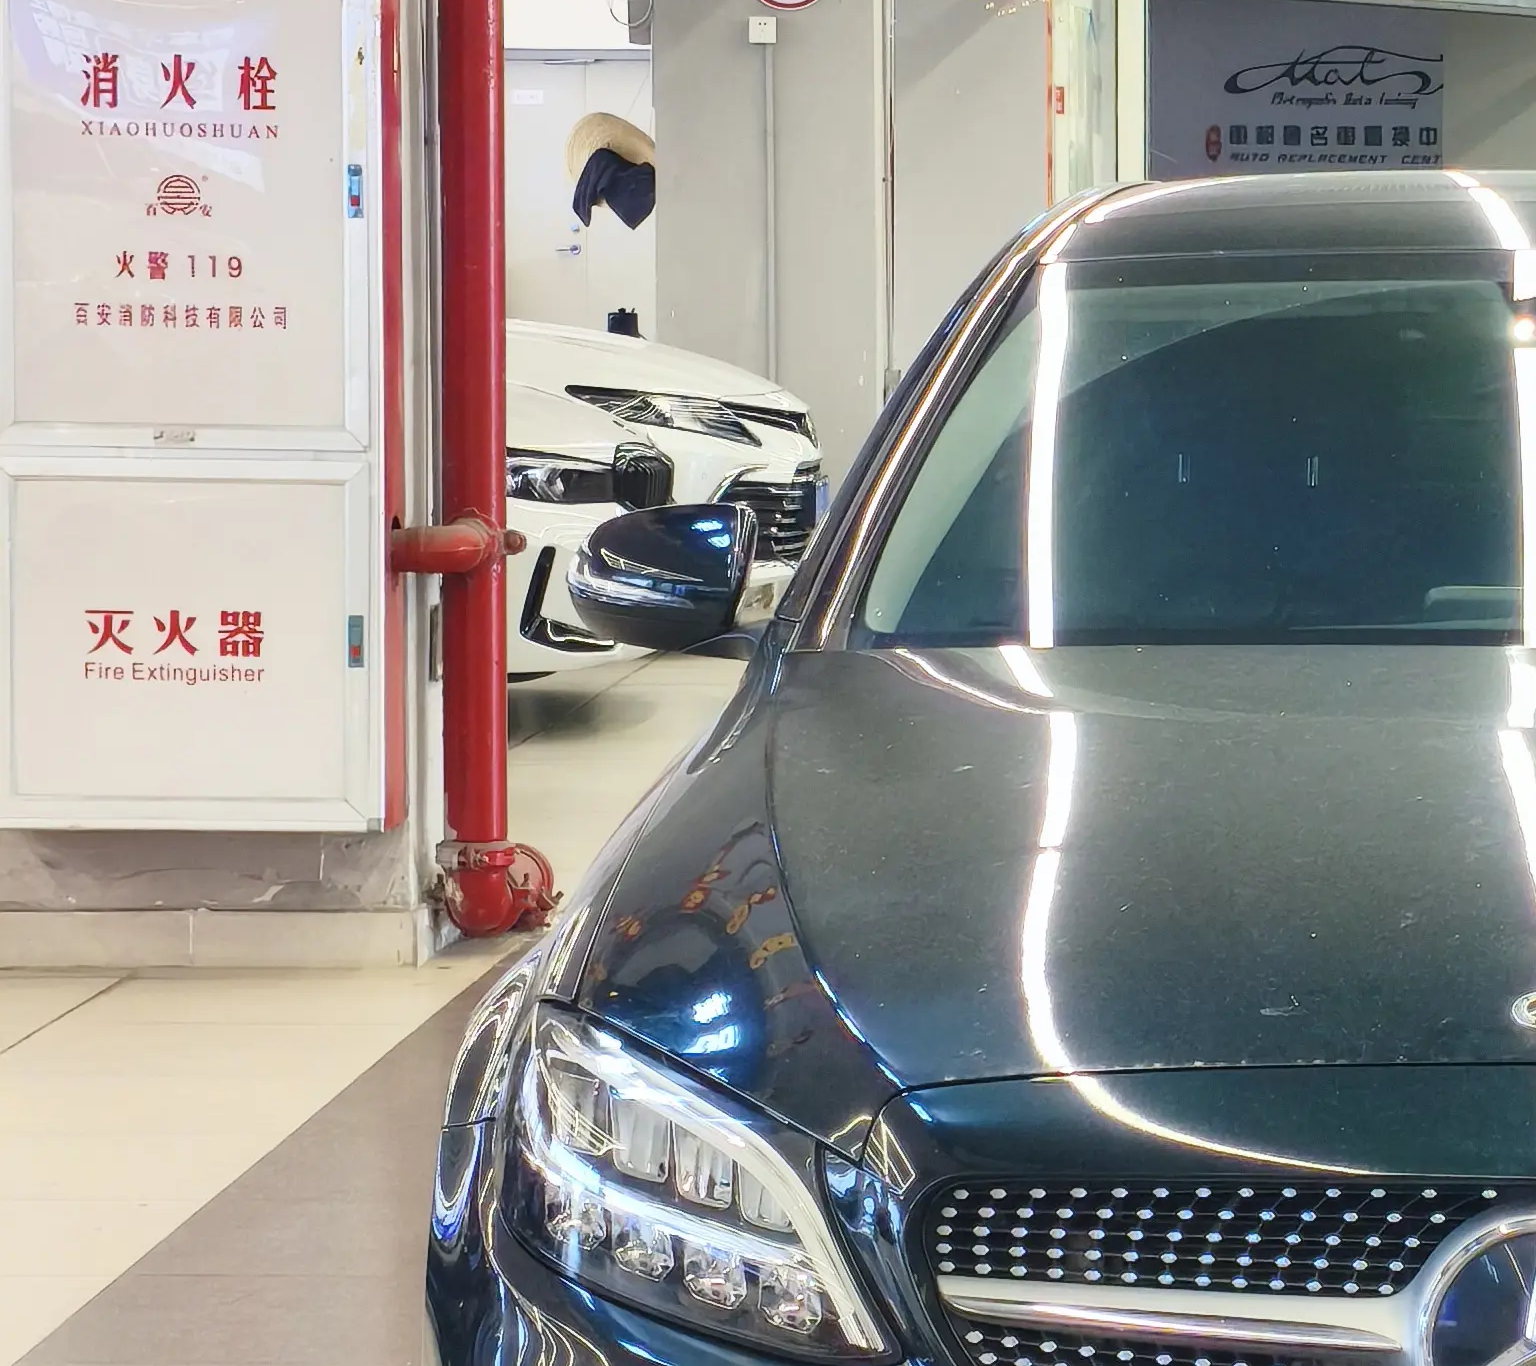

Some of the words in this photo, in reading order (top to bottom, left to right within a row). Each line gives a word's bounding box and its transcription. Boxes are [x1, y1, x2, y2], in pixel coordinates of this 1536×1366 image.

[80, 52, 277, 111] 消火栓
[81, 120, 279, 139] XIAOHUOSHUAN
[74, 302, 288, 330] 百安消防科技有限公司
[84, 610, 265, 657] 灭火器
[84, 662, 125, 680] Fire
[132, 662, 265, 686] Extinguisher
